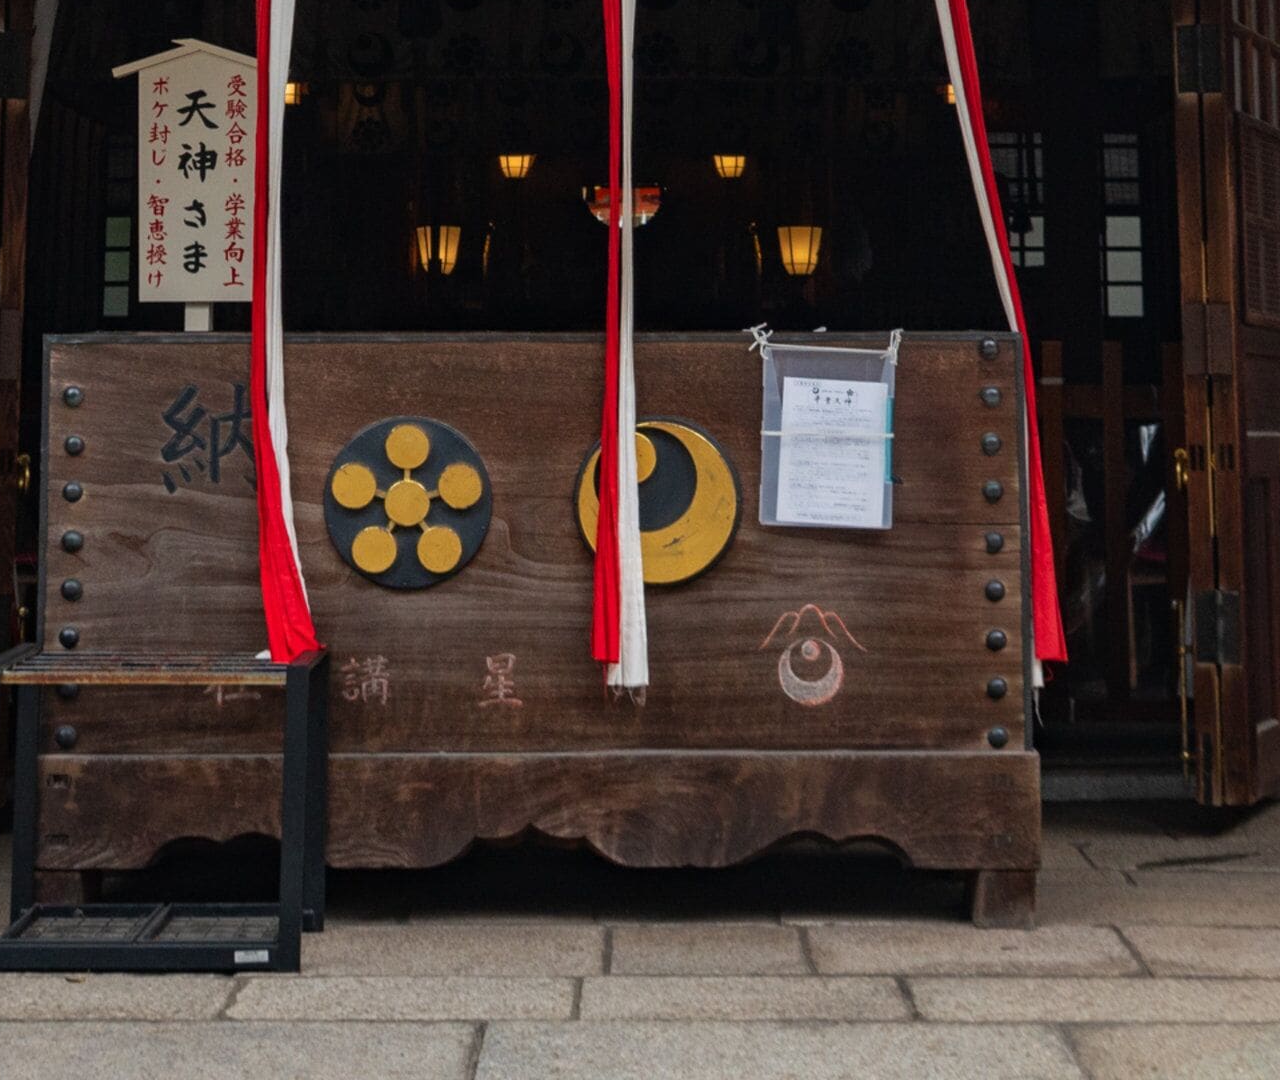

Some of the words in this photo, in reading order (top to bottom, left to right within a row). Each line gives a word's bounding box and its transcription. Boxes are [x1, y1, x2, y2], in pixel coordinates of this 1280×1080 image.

[176, 90, 219, 274] 天神さま
[223, 74, 248, 286] 受験合格・学業向上
